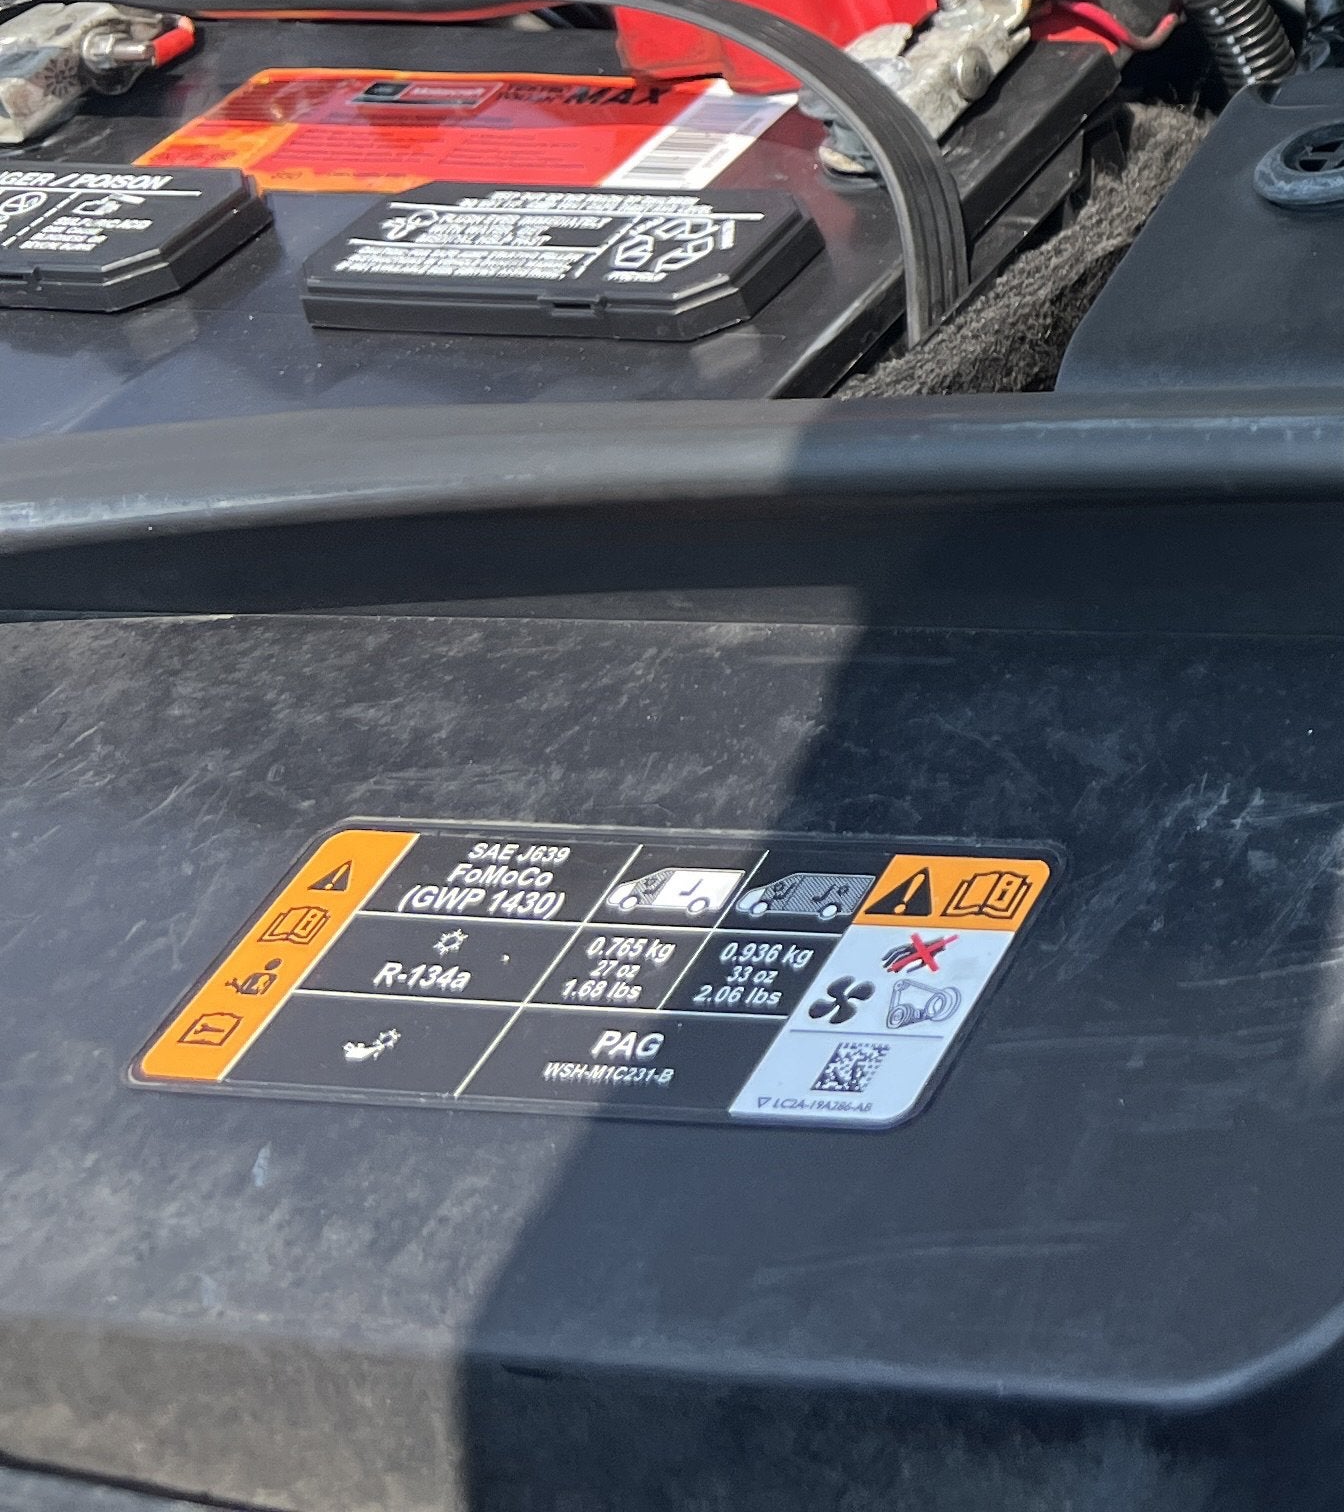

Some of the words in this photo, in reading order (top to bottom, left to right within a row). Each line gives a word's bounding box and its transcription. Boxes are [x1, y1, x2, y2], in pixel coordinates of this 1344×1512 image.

[69, 174, 174, 190] POISON
[468, 842, 520, 863] SAE
[517, 845, 572, 865] J639
[447, 863, 554, 888] FoMoCo
[397, 885, 488, 914] (GWP
[488, 890, 565, 920] 1430)
[586, 936, 648, 959] 0.765
[647, 939, 676, 965] kg
[719, 942, 783, 964] 0.936
[783, 944, 814, 970] kg
[373, 961, 473, 992] R-134a
[590, 960, 614, 978] 27
[615, 964, 641, 980] oz
[727, 965, 753, 982] 33
[752, 969, 779, 984] oz
[561, 979, 609, 999] 1.68
[607, 981, 642, 1001] lbs
[693, 987, 743, 1005] 2.06
[744, 987, 782, 1007] lbs
[590, 1030, 665, 1060] PAG
[543, 1062, 675, 1085] WSH-M1C231-B
